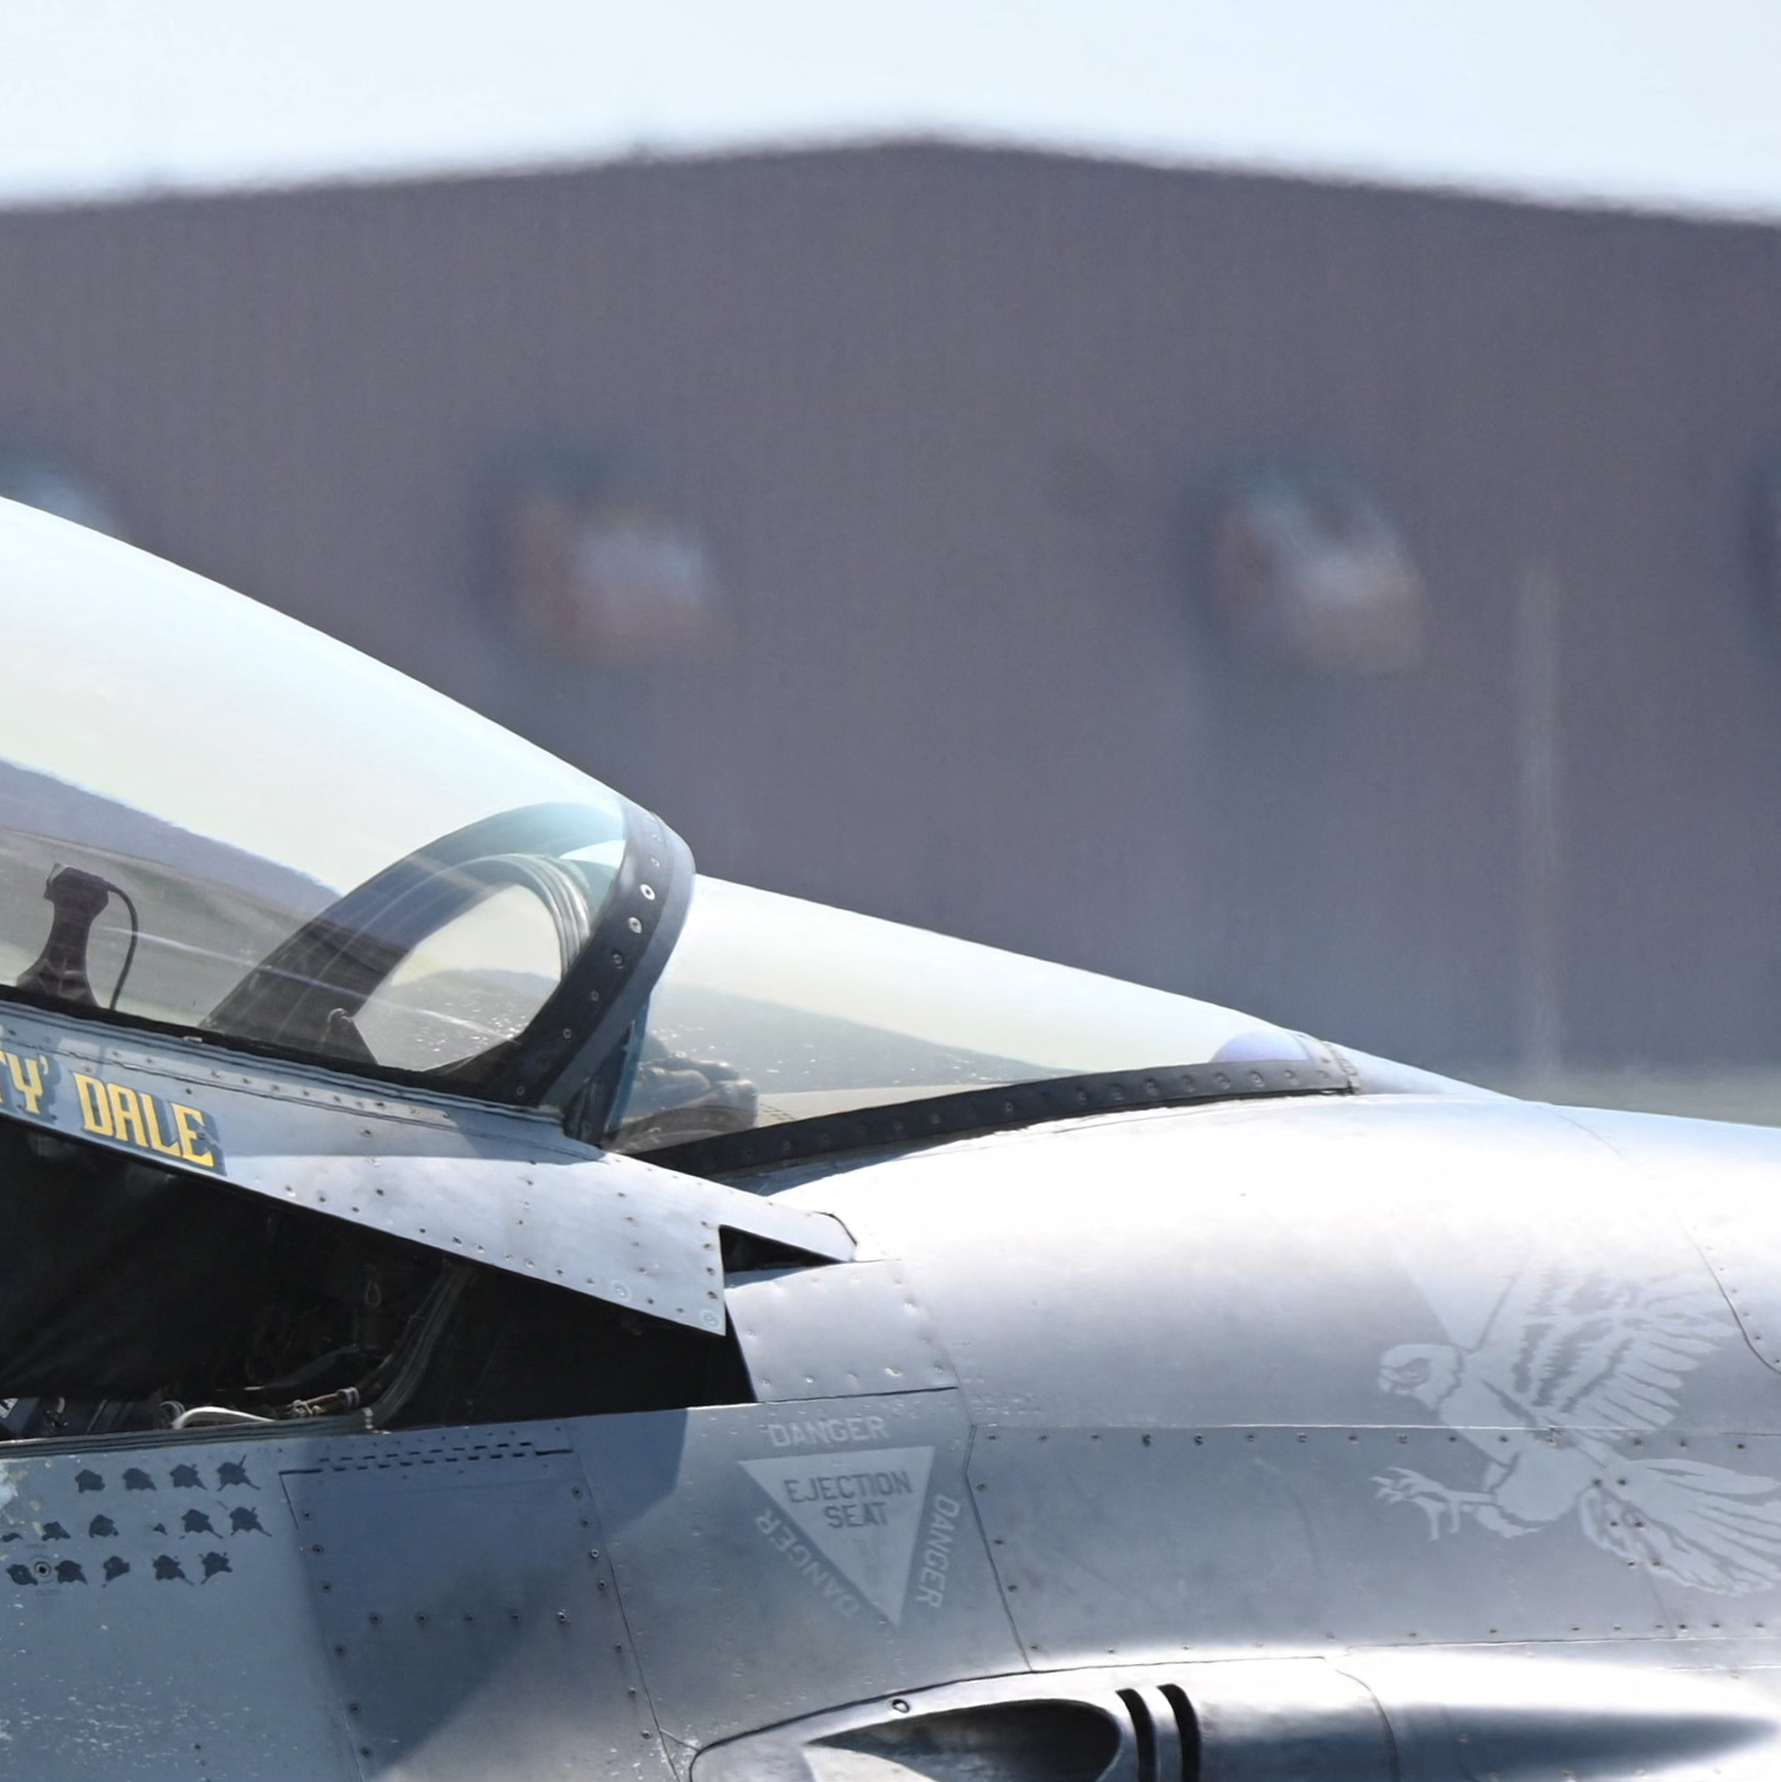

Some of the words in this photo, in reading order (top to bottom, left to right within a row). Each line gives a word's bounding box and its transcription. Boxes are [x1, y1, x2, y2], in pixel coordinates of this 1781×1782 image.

[71, 1071, 214, 1168] DALE
[768, 1415, 889, 1447] DANGER
[784, 1469, 914, 1504] EJECTION
[825, 1502, 888, 1529] SEAT
[754, 1508, 861, 1617] DANGER
[916, 1493, 961, 1608] DANGER
